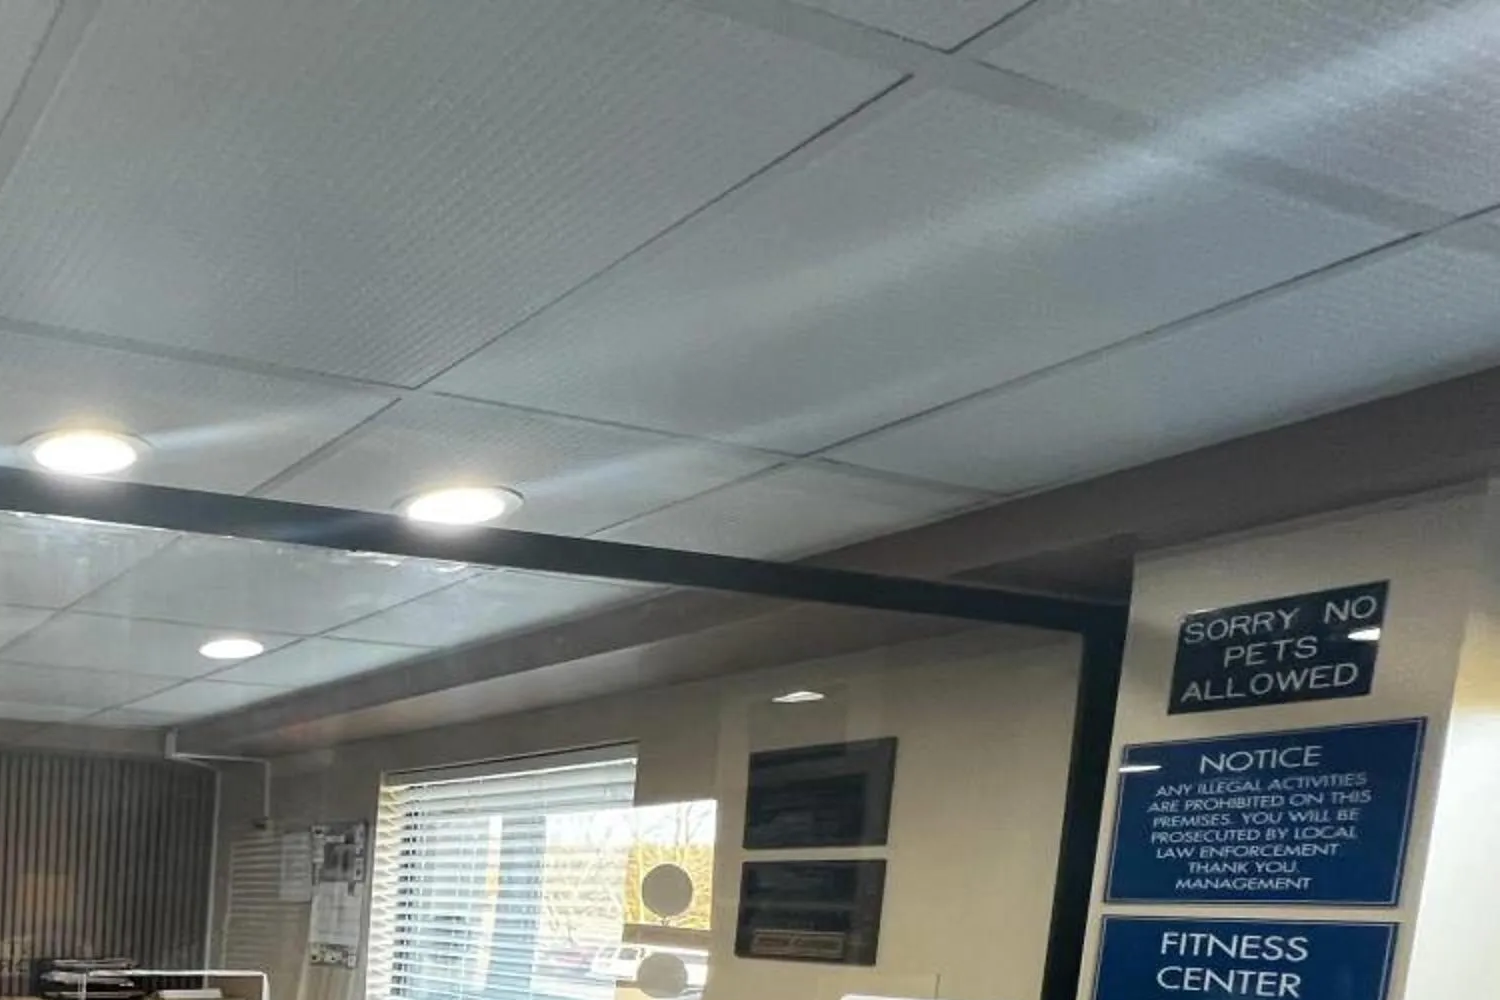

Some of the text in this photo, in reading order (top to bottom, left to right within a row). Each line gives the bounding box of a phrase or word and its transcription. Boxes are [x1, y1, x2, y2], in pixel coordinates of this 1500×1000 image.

[1183, 595, 1377, 644] SORRY NO
[1223, 635, 1318, 668] PETS
[1181, 662, 1359, 703] ALLOWED
[1199, 745, 1323, 775] NOTICE
[1156, 771, 1368, 797] ANY ILLEGAL ACTIVITIES
[1147, 789, 1372, 813] ARE PROHIBITED ON THIS
[1242, 811, 1282, 825] YOU
[1288, 809, 1331, 823] WILL
[1336, 808, 1361, 821] BE
[1151, 826, 1358, 844] PROSECUTED BY LOCAL
[1156, 847, 1195, 859] LAW
[1188, 861, 1249, 873] THANK
[1175, 877, 1312, 891] MANAGEMENT
[1160, 931, 1309, 962] FITNESS
[1156, 966, 1301, 998] CENTER
